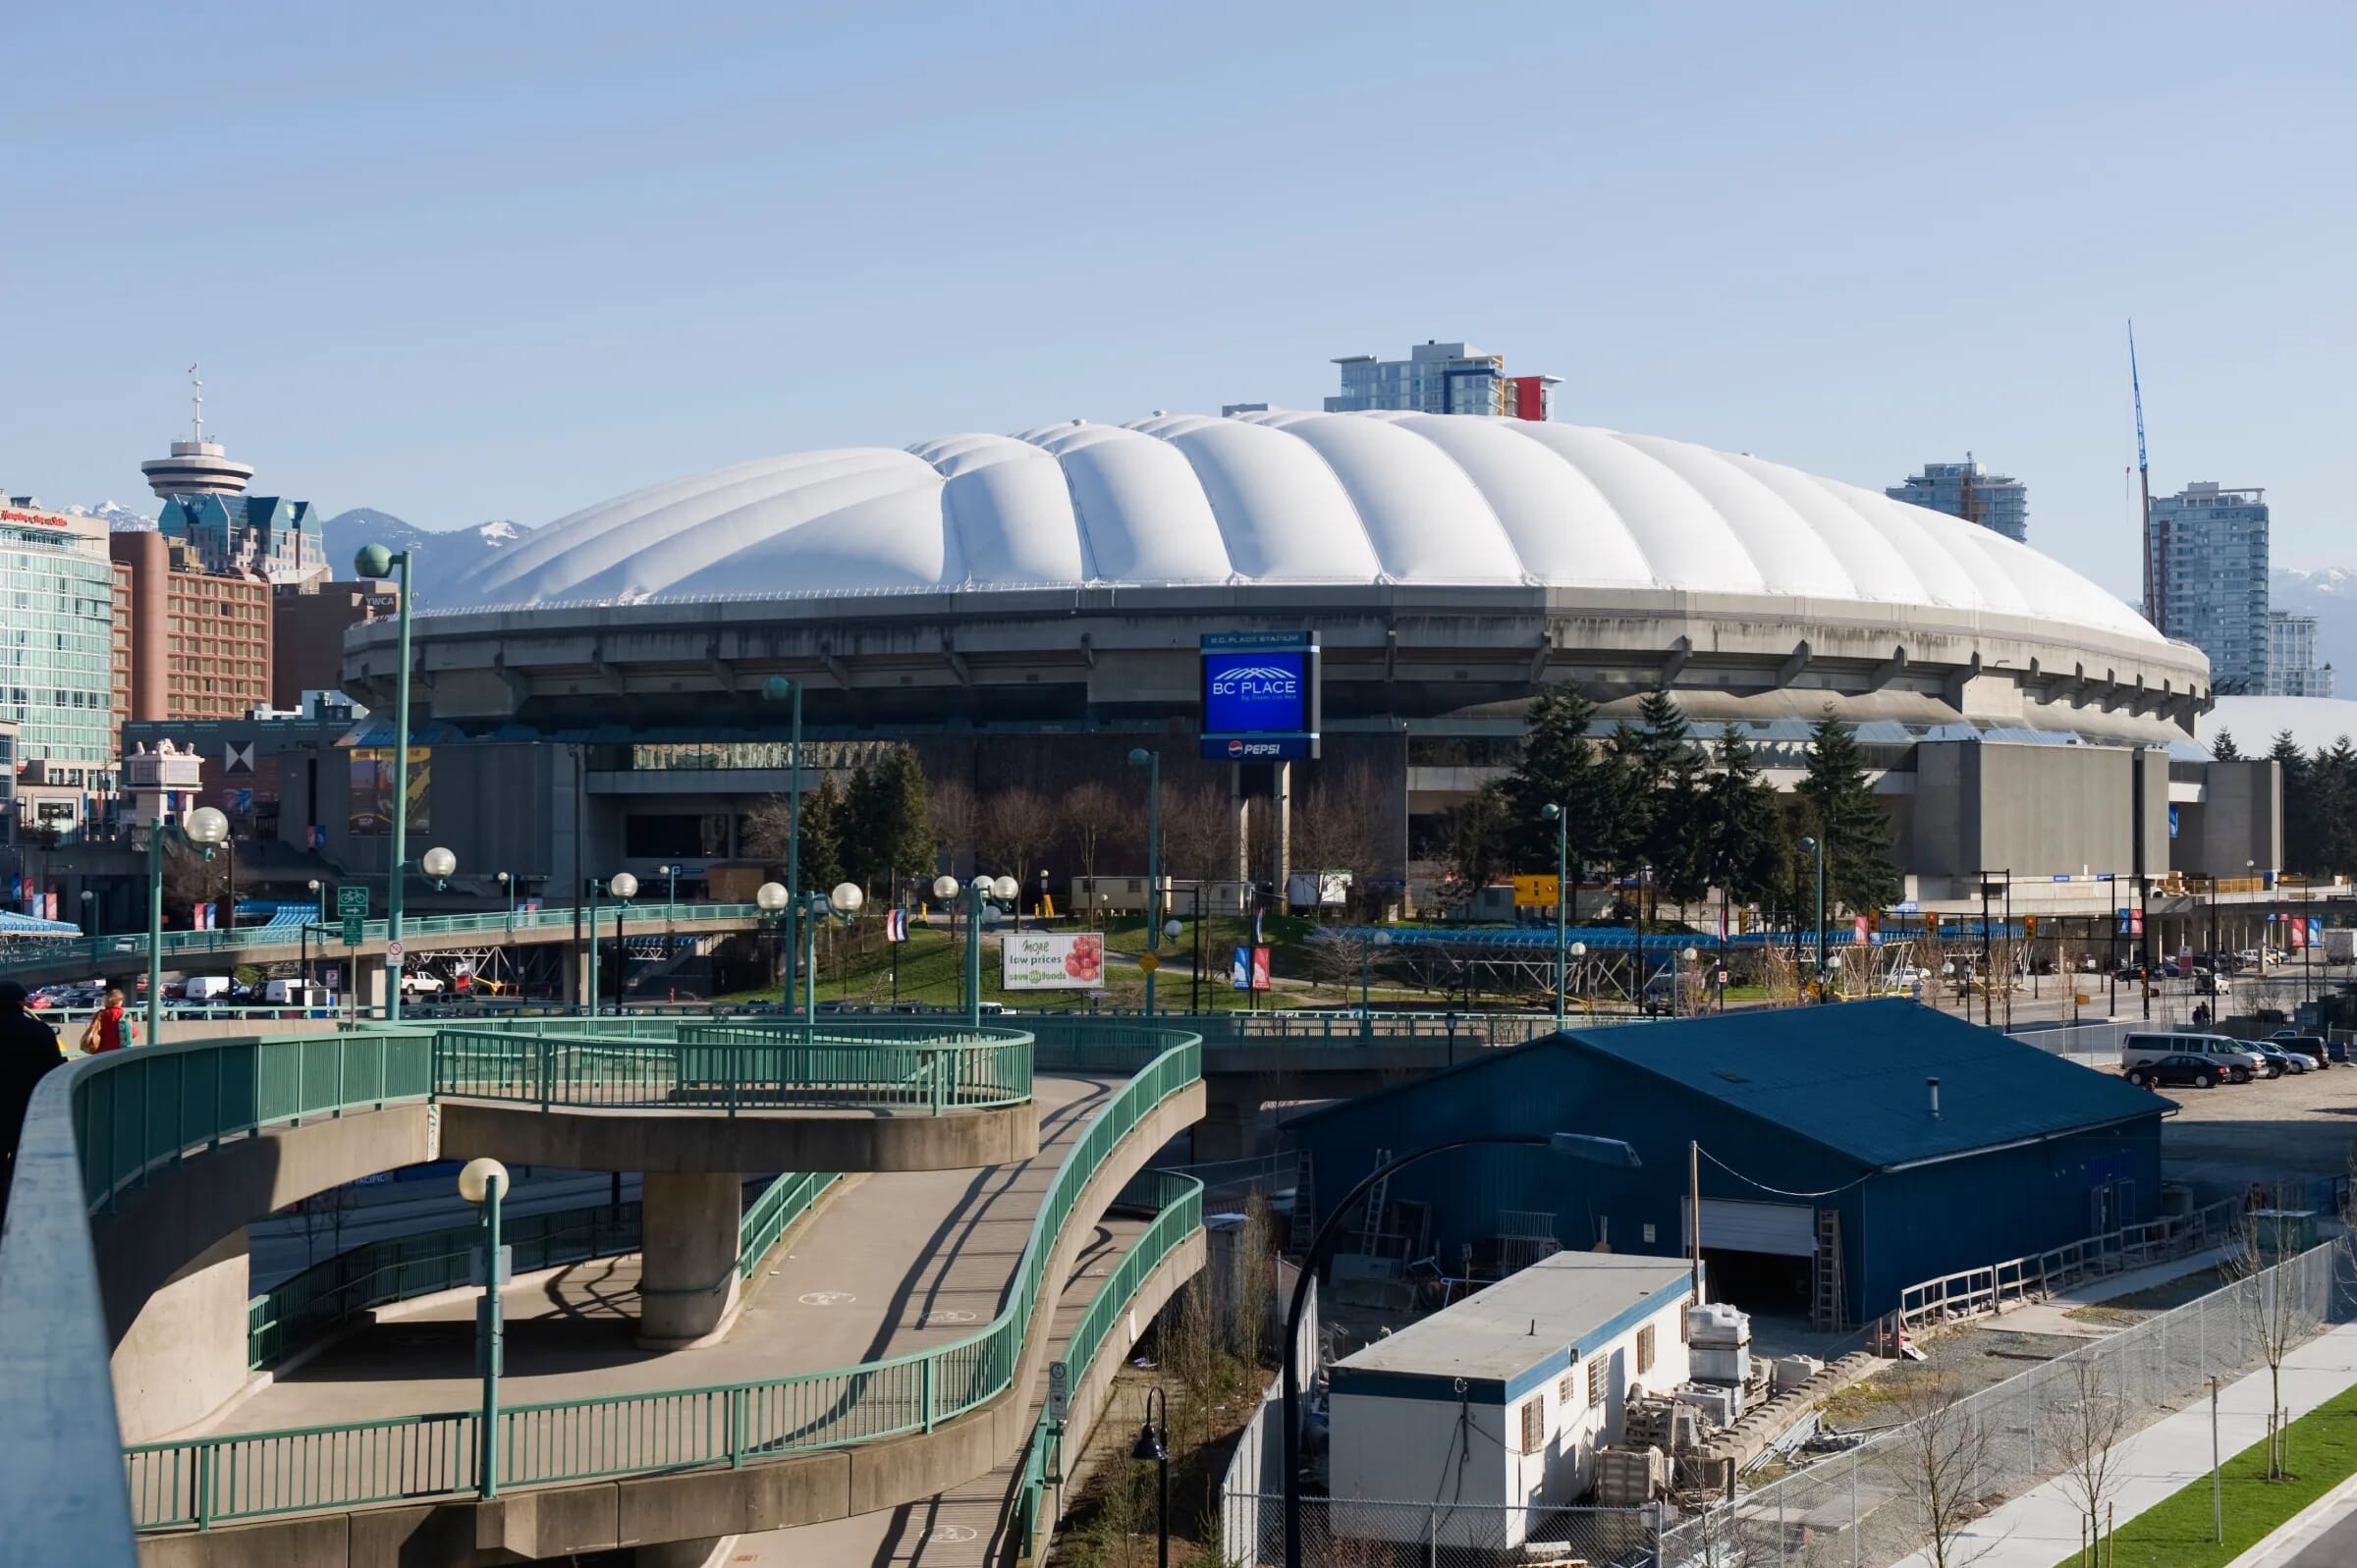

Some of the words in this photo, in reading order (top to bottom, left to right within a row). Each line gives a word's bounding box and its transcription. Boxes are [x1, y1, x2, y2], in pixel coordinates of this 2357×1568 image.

[366, 597, 394, 605] YWCA
[1213, 682, 1235, 695] BC
[1240, 680, 1296, 694] PLACE
[1243, 744, 1281, 755] PEPSI
[1010, 955, 1028, 965] low
[1030, 955, 1062, 966] prices
